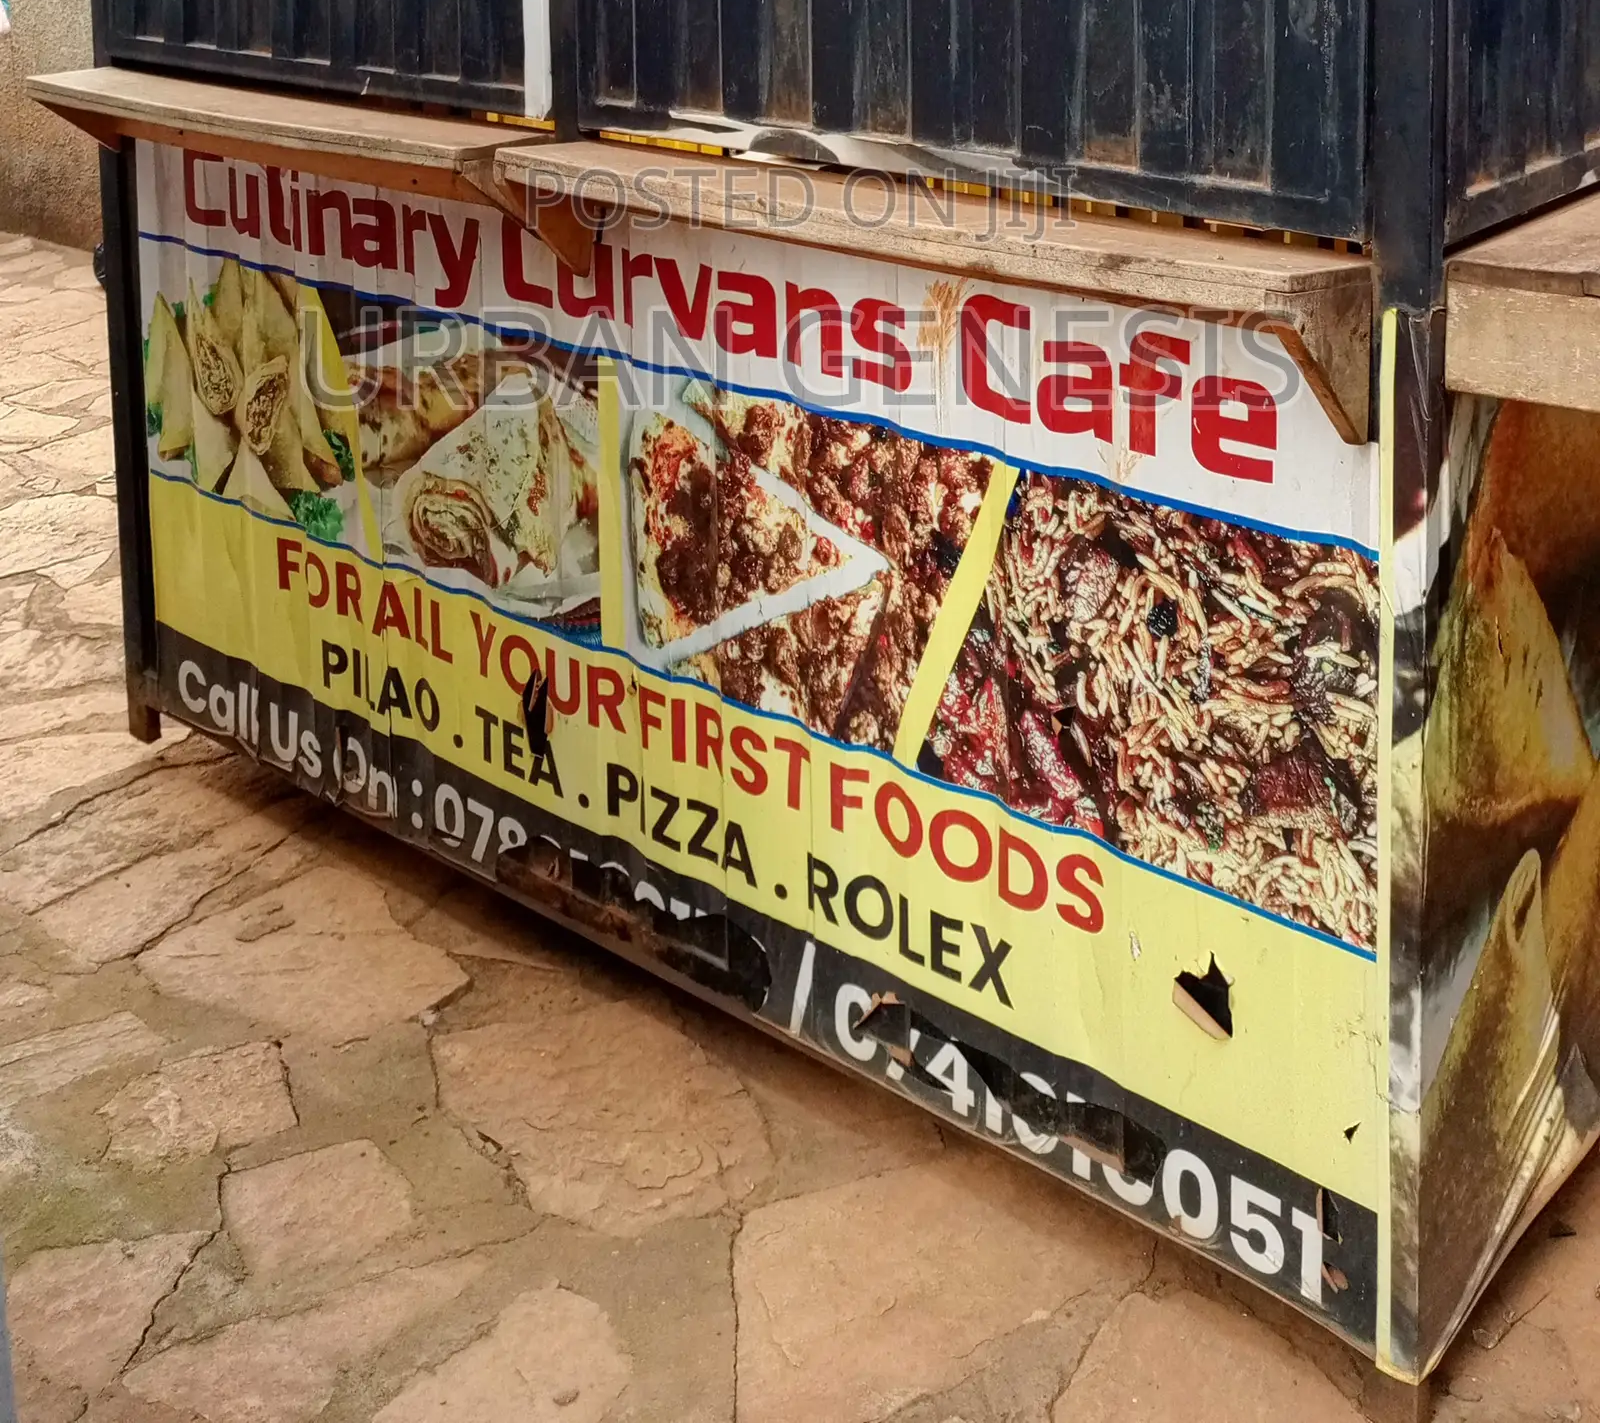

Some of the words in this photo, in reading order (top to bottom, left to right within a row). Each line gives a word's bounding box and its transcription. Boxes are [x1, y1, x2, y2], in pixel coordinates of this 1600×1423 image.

[183, 149, 479, 308] Culinary
[501, 213, 913, 393] Curvans
[959, 293, 1278, 484] Cafe
[178, 660, 259, 746] Call
[269, 701, 322, 778] Us
[333, 736, 398, 819] On
[276, 537, 364, 623] FOR
[371, 580, 454, 665] ALL
[469, 609, 627, 734] YOUR
[638, 685, 811, 811] FIRST
[828, 762, 1105, 934] FOODS
[321, 638, 441, 730] PILAO
[475, 705, 564, 798] TEA
[606, 762, 759, 890] PIZZA
[806, 851, 1015, 1011] ROLEX
